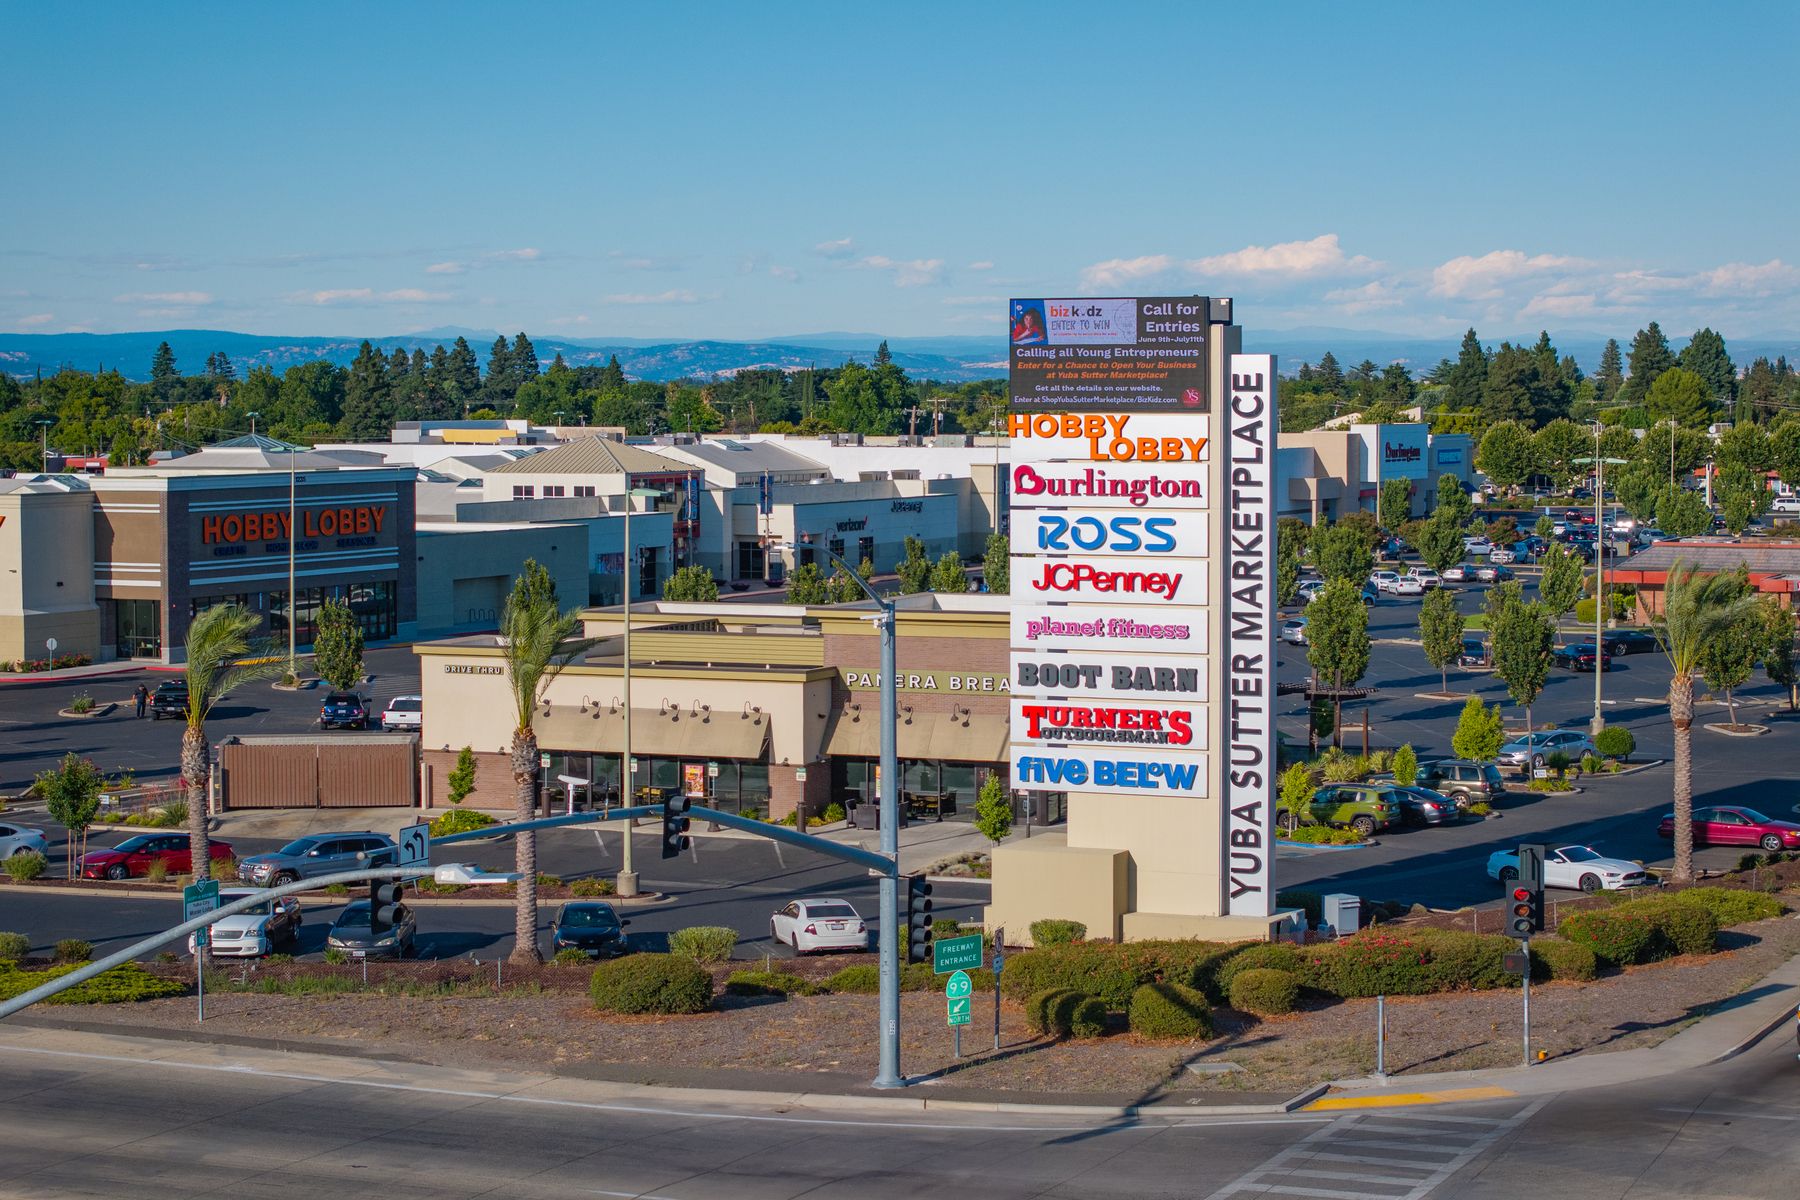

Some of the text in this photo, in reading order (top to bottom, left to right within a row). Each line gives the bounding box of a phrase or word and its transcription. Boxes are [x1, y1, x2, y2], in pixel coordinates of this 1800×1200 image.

[1050, 305, 1102, 317] biz kdz
[1143, 303, 1199, 315] Call for
[1051, 319, 1111, 331] ENTER TO WIN
[1145, 321, 1200, 333] Entries
[1016, 347, 1199, 360] Calling all Young Entrepreneurs
[1017, 361, 1041, 369] Enter
[1043, 361, 1056, 369] for
[1065, 361, 1097, 369] Chance
[1100, 361, 1109, 369] to
[1111, 361, 1134, 370] Open
[1136, 361, 1155, 369] Your
[1157, 361, 1197, 369] Business
[1058, 371, 1079, 379] Yuba
[1081, 371, 1108, 379] Sutter
[1110, 371, 1169, 380] Marketplace!
[1014, 395, 1032, 403] Enter
[1008, 414, 1131, 439] HOBBY
[1089, 436, 1208, 462] LOBBY
[1013, 464, 1203, 507] Burlington
[202, 505, 386, 545] HOBBY LOBBY
[836, 517, 865, 532] verizon
[1038, 515, 1177, 552] ROSS
[1032, 563, 1182, 600] JCPenney
[1026, 616, 1190, 640] planet fitness
[1230, 372, 1264, 899] YUBA SUTTER MARKETPLACE
[445, 664, 502, 675] DRIVE THRU
[846, 672, 1011, 692] PAERA BREA
[1018, 662, 1199, 693] BOOT BARN
[1022, 705, 1193, 745] TURNER'S
[1040, 727, 1169, 744] OUTDOORSMAN
[1016, 756, 1198, 791] five BELOW
[942, 942, 975, 954] FREEWAY
[940, 953, 977, 966] ENTRANCE
[949, 981, 969, 994] 99
[949, 1015, 970, 1024] NORTH
